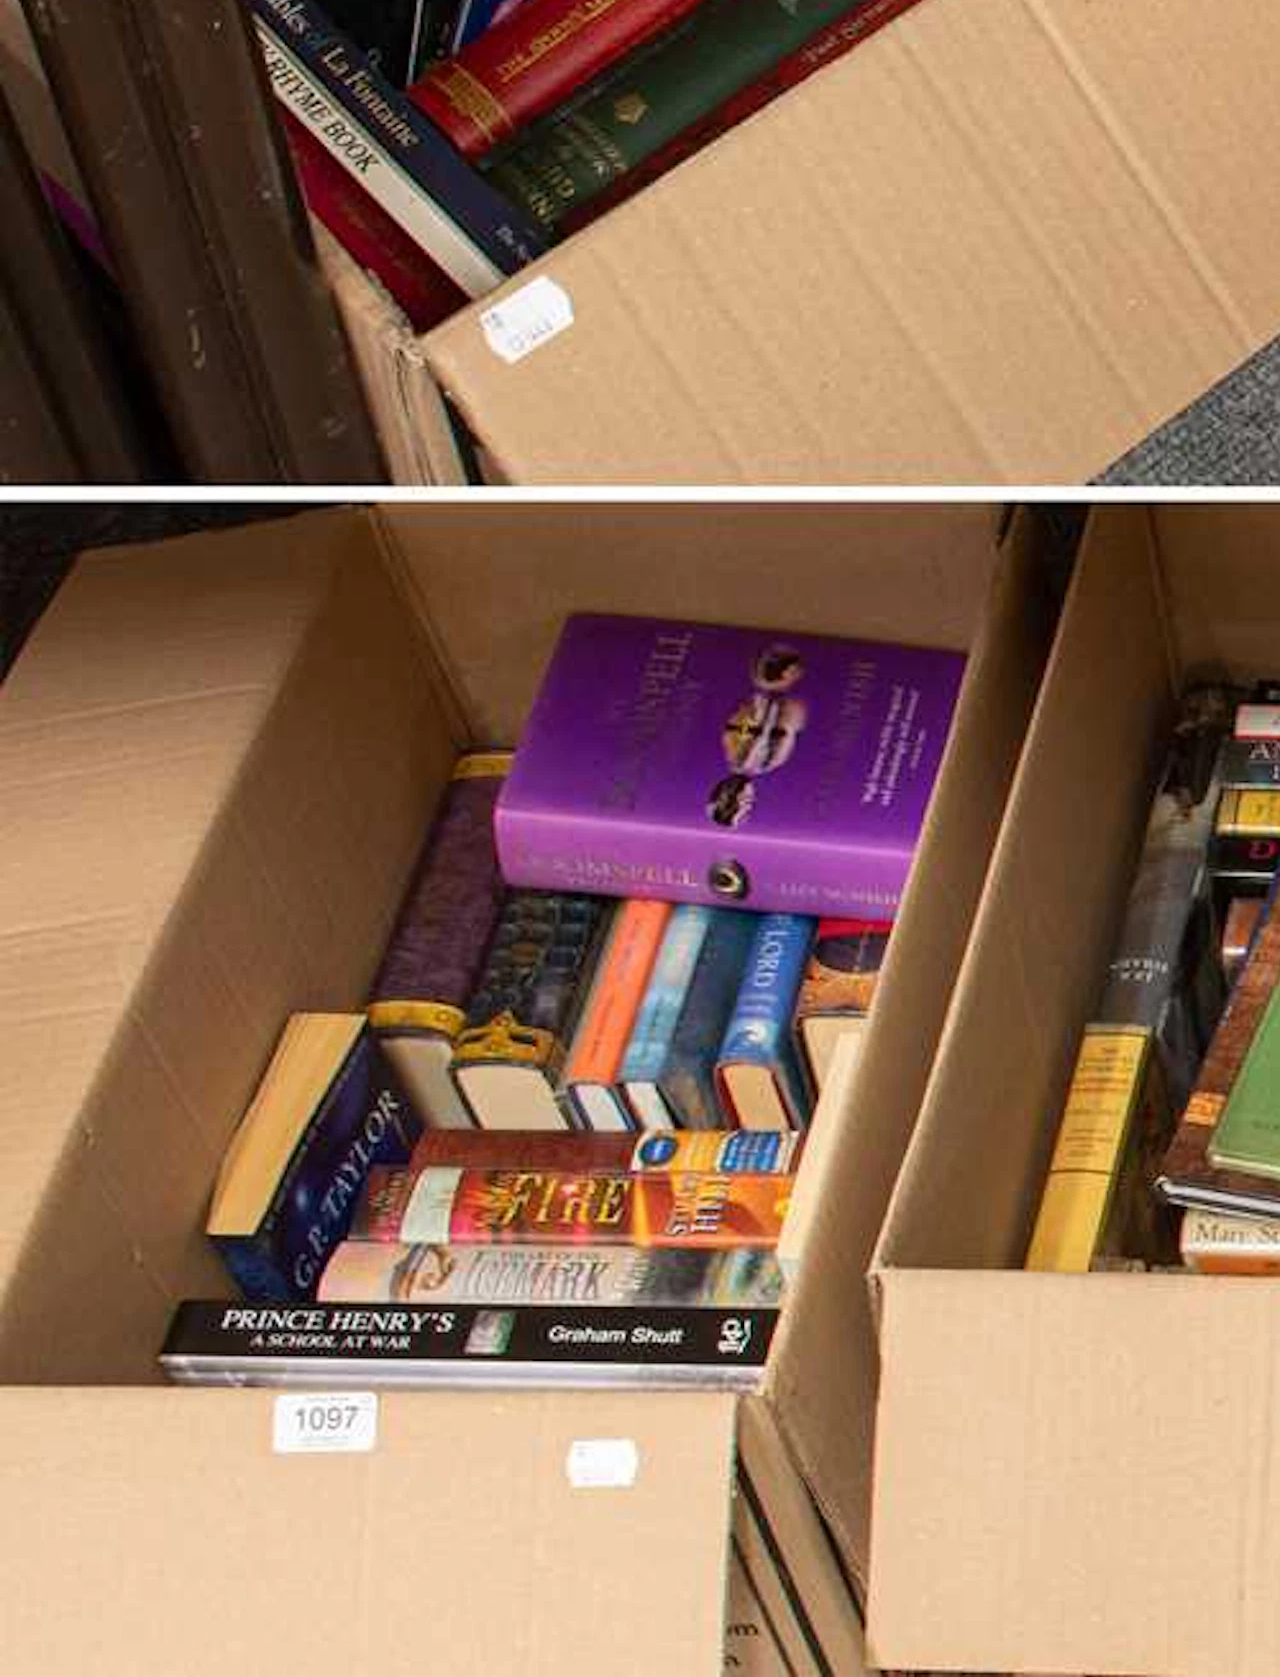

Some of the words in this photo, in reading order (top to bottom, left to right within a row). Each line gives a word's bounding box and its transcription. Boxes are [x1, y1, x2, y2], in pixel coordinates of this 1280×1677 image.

[262, 51, 334, 127] RHYME
[322, 113, 382, 175] BOOK
[751, 927, 792, 990] LORD
[322, 1088, 402, 1221] TAYLOR
[502, 1171, 636, 1227] FIRE
[222, 1308, 325, 1333] PRINCE
[326, 1309, 456, 1335] HENRY'S
[548, 1323, 628, 1347] Graham
[632, 1324, 685, 1347] Shutt
[249, 1334, 263, 1349] A
[264, 1334, 336, 1350] SCHOOL
[340, 1335, 369, 1350] AT
[369, 1335, 413, 1351] WAR
[293, 1405, 359, 1432] 1097
